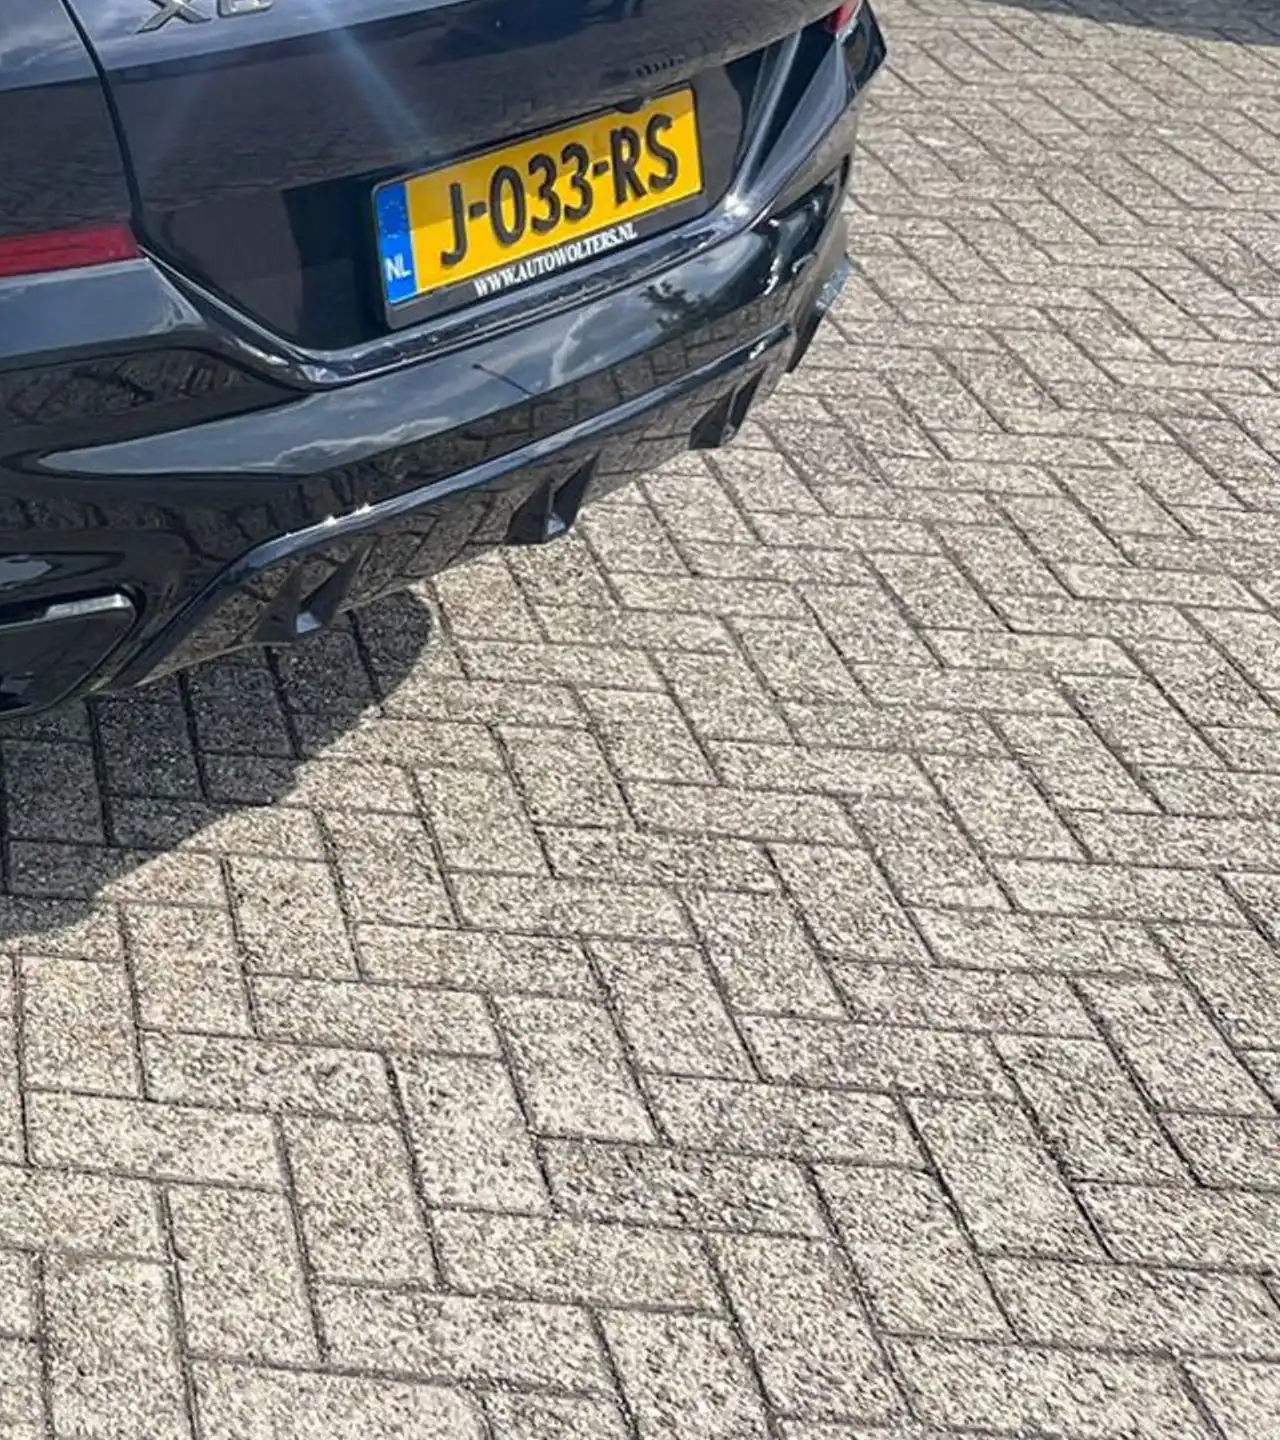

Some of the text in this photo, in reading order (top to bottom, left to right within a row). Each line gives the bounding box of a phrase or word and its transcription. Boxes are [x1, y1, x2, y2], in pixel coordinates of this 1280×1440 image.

[440, 113, 679, 268] J-033-RS
[385, 253, 411, 282] NL
[473, 221, 638, 298] WWW.AUTOWOLTERS.NL
